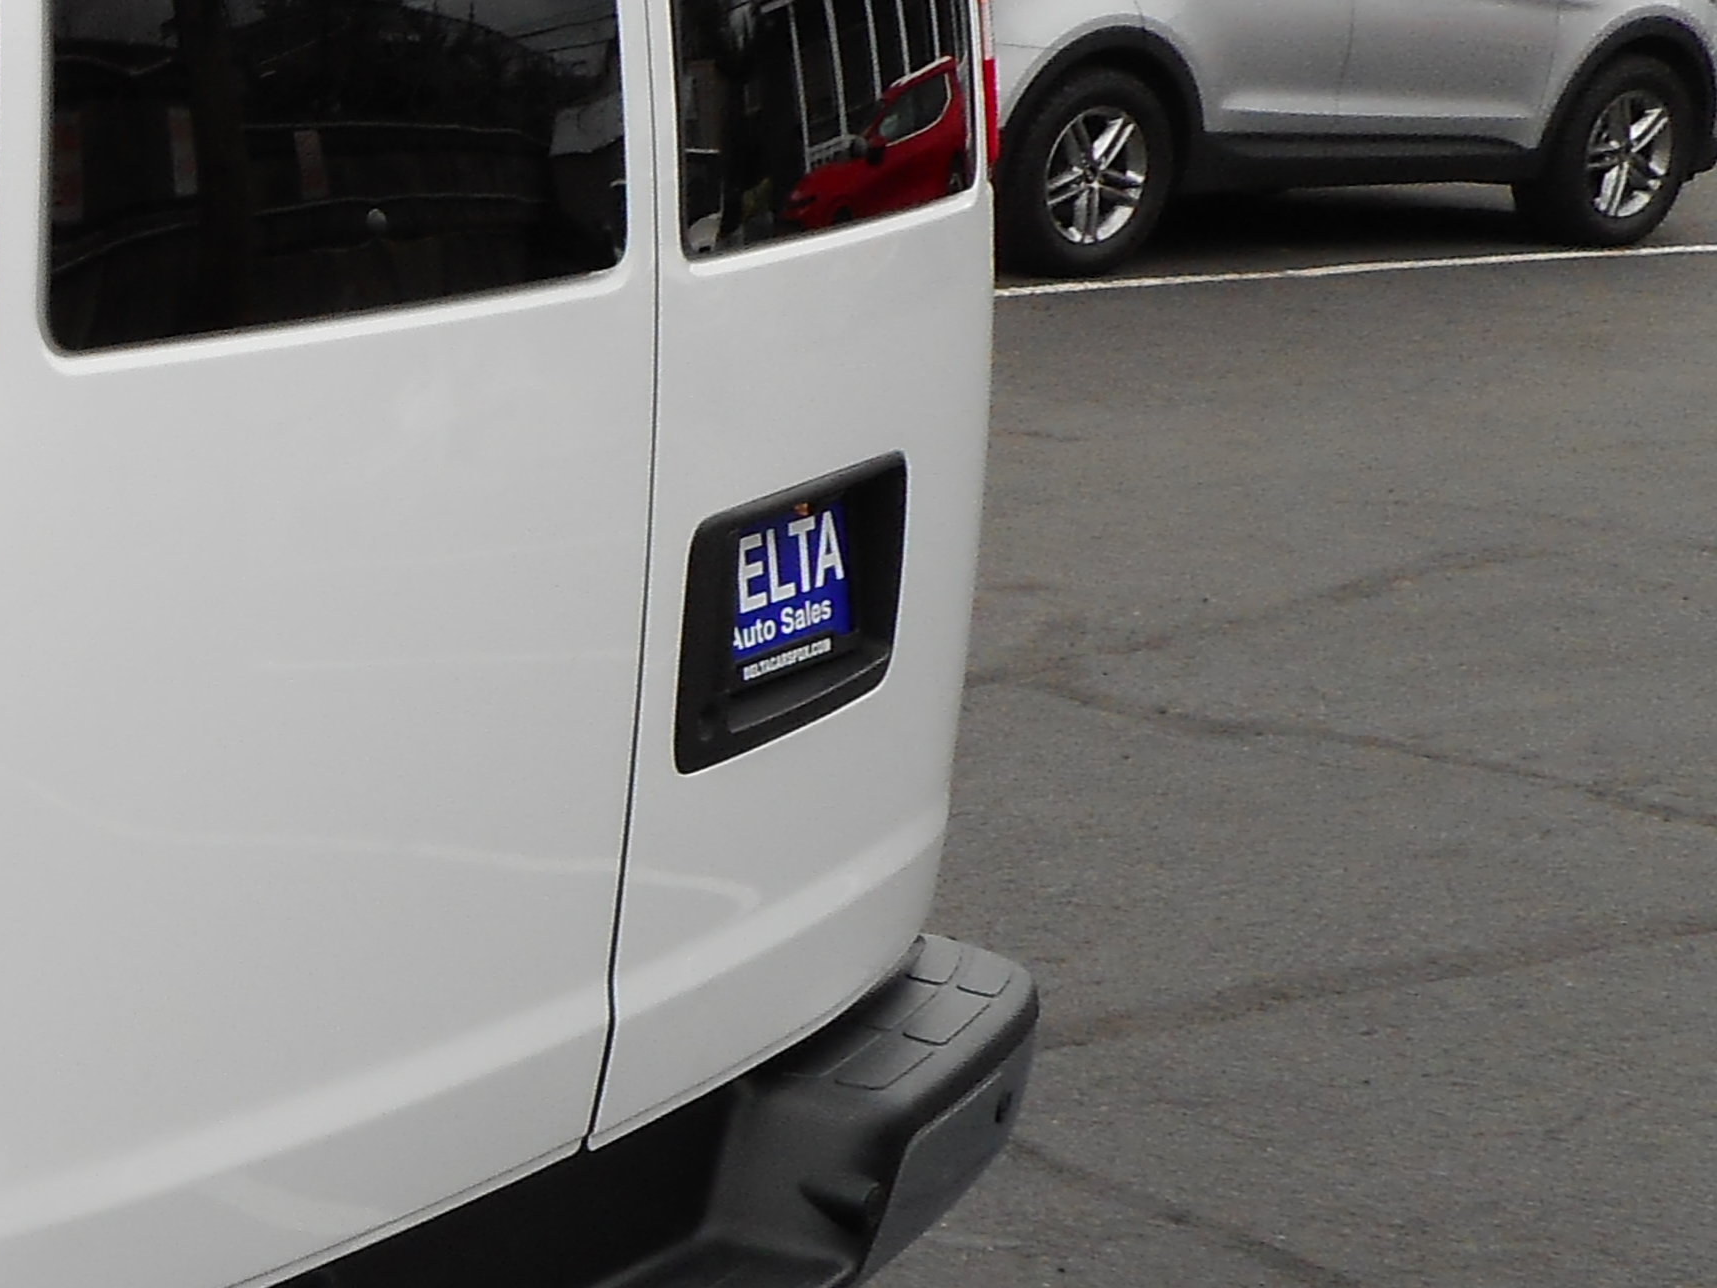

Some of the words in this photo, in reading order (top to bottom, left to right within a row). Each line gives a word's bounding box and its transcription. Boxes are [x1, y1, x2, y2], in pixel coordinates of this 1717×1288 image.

[737, 510, 845, 614] ELTA
[732, 618, 777, 650] Auto
[780, 597, 832, 635] Sales
